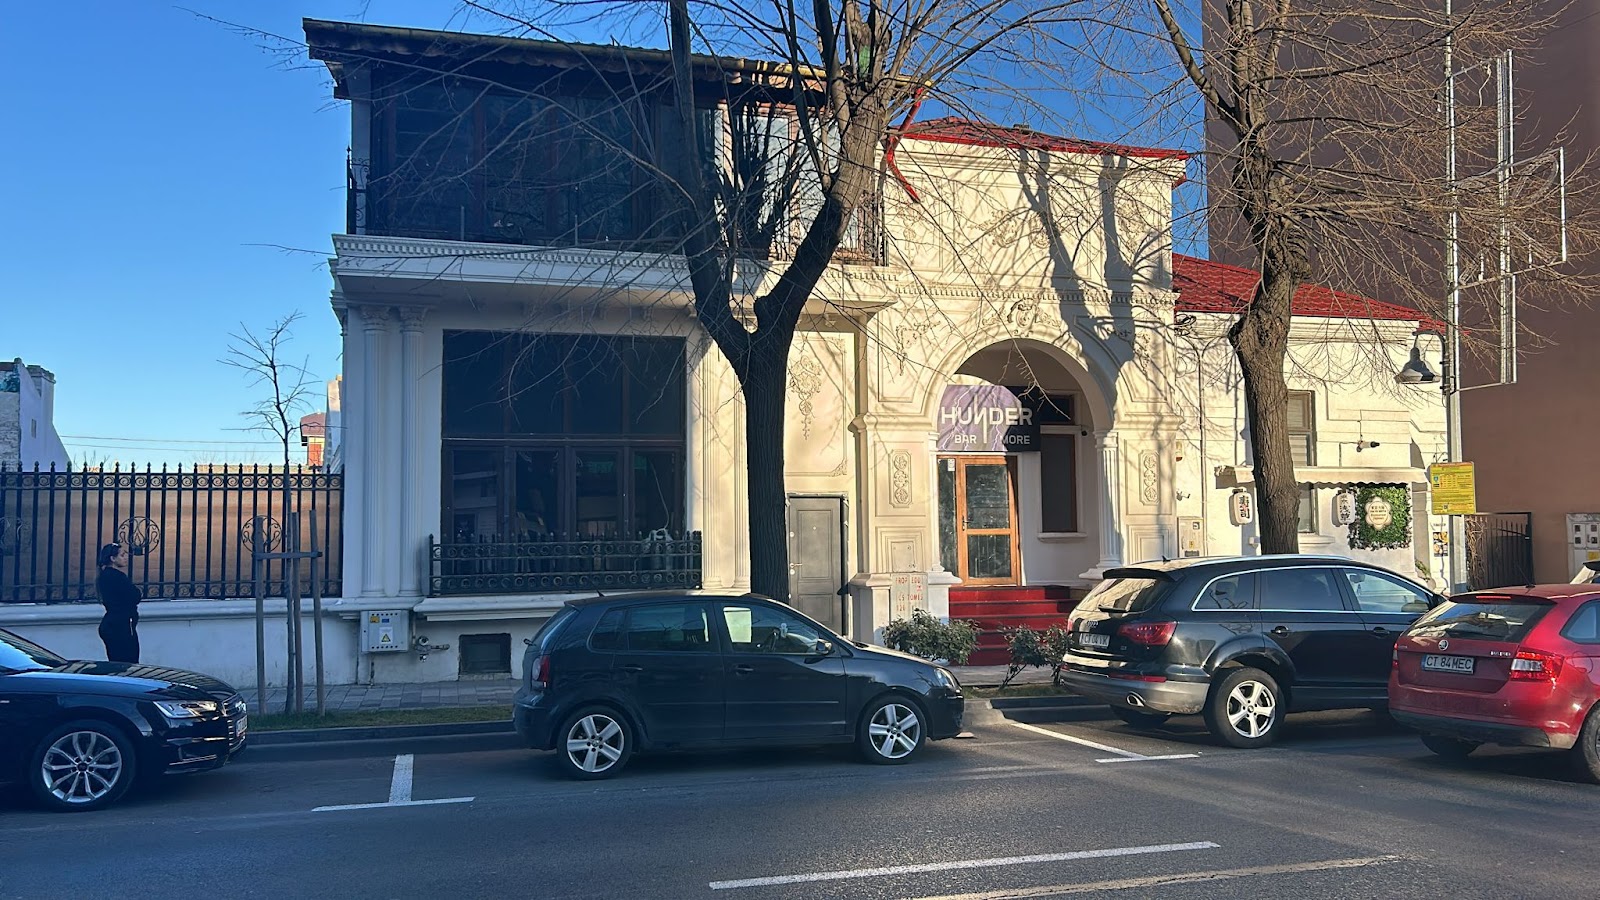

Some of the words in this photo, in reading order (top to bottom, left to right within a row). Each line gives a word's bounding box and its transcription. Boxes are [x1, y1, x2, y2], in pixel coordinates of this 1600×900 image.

[954, 434, 977, 444] BAR
[1000, 434, 1030, 444] MORE
[1426, 656, 1440, 667] CT
[1440, 657, 1451, 668] 84
[1451, 657, 1474, 670] MEC
